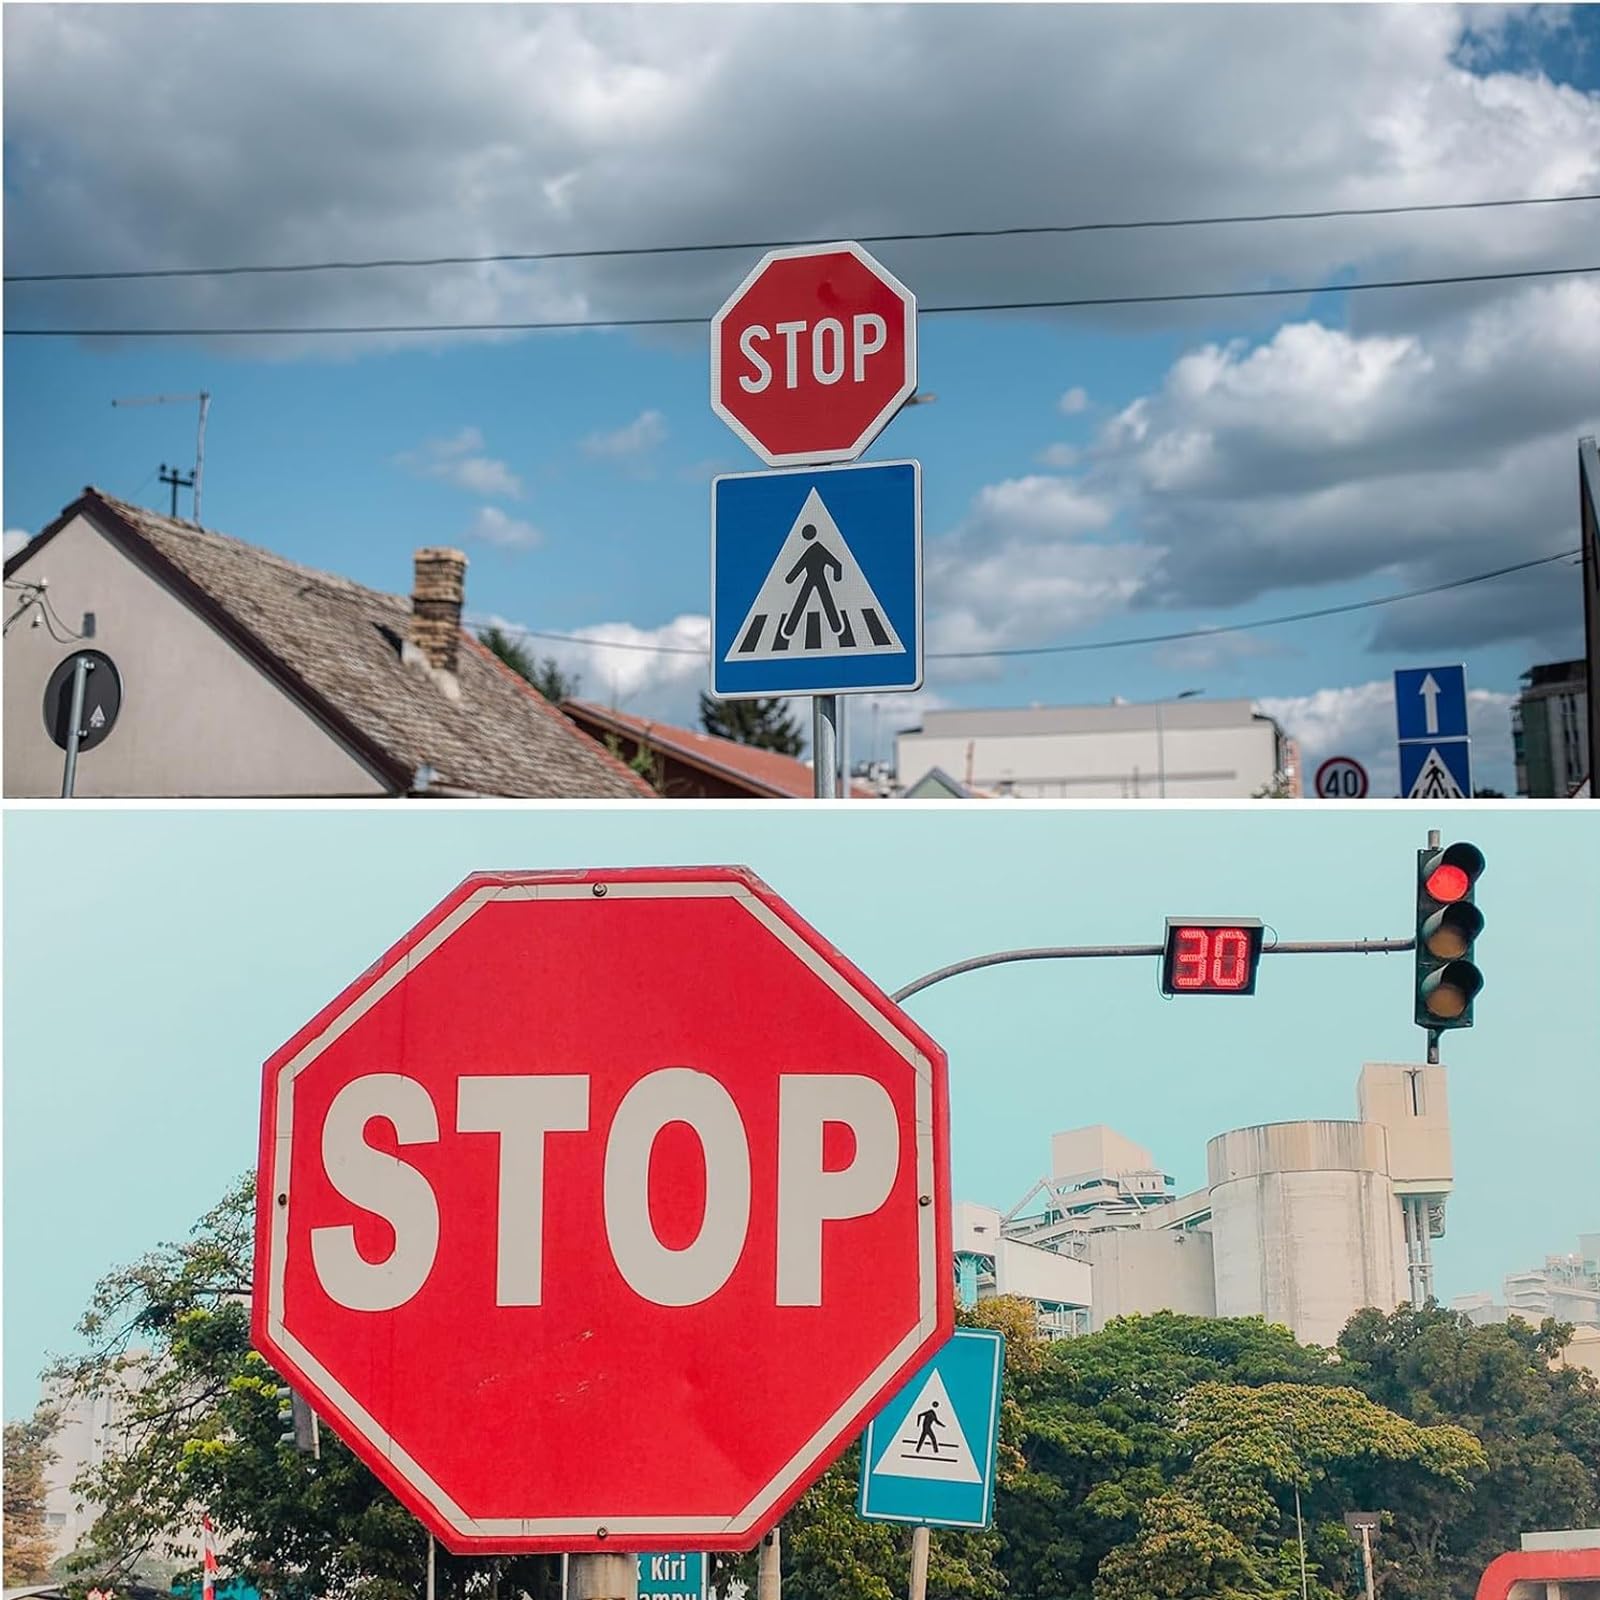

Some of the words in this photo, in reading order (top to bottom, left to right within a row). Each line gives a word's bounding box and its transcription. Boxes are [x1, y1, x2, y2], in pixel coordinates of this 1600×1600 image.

[738, 313, 887, 393] STOP
[1325, 769, 1358, 798] 40
[1177, 930, 1247, 986] 30
[310, 1067, 900, 1312] STOP
[652, 1554, 686, 1581] Kiri
